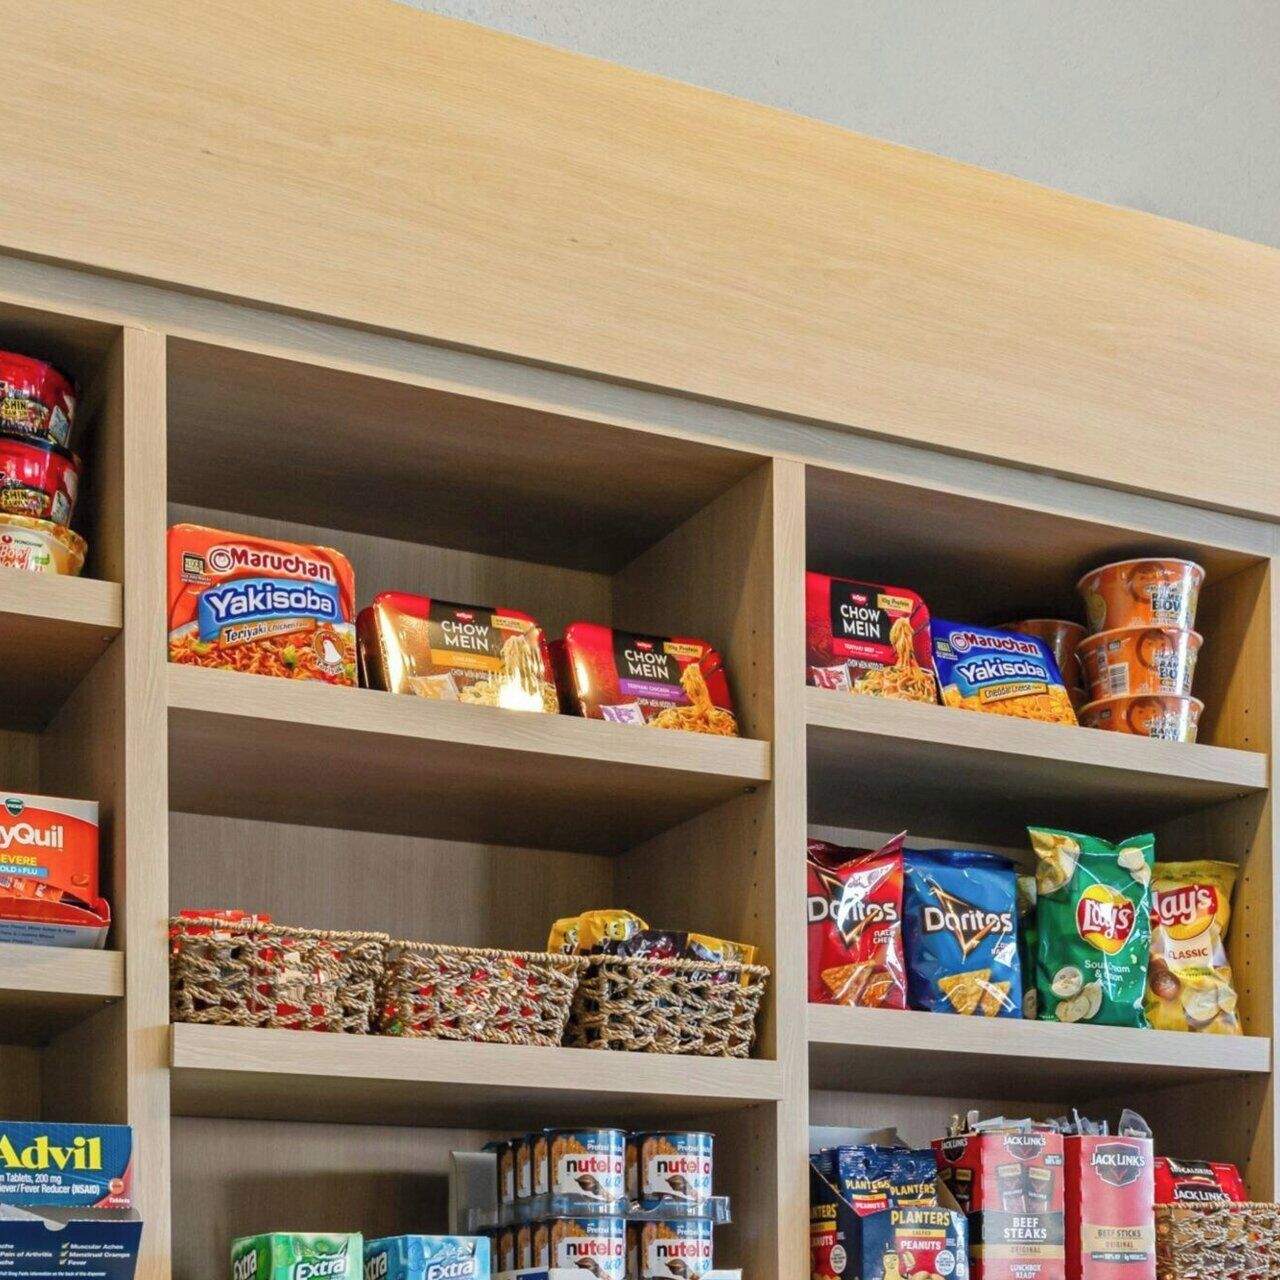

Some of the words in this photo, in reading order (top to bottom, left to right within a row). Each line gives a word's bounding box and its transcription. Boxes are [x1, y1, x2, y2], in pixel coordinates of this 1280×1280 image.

[4, 399, 27, 411] SHIN
[3, 489, 27, 501] SHIN
[230, 547, 331, 580] Maruchan
[210, 585, 333, 618] Yakisoba
[840, 604, 880, 622] CHOW
[440, 620, 489, 637] CHOW
[843, 618, 880, 638] MEIN
[444, 633, 489, 651] MEIN
[964, 632, 1039, 654] Maruchan
[624, 649, 668, 665] CHOW
[628, 661, 670, 679] MEIN
[961, 659, 1046, 682] Yakisoba
[22, 867, 38, 876] FLU
[924, 907, 1013, 932] Doritos
[1082, 900, 1132, 938] Lay's
[1168, 947, 1209, 961] CLASSIC
[1003, 1136, 1023, 1146] JACK
[1023, 1136, 1047, 1146] LINK'S
[1090, 1153, 1116, 1166] JACK
[1116, 1153, 1146, 1167] LINK'S
[6, 1172, 34, 1184] Tablets,
[35, 1174, 49, 1183] 200
[50, 1176, 62, 1185] mg
[889, 1183, 936, 1196] PLANTERS
[1173, 1188, 1199, 1200] JACK
[1199, 1191, 1231, 1202] LINK'S
[855, 1201, 886, 1210] PEANUTS
[890, 1210, 950, 1227] PLANTERS
[1012, 1217, 1039, 1229] BEEF
[1003, 1228, 1048, 1240] STEAKS
[1097, 1229, 1116, 1238] BEEF
[1116, 1229, 1142, 1238] STICKS
[900, 1240, 941, 1251] PEANUTS
[1010, 1263, 1042, 1272] LUNCHBOX
[1015, 1271, 1036, 1280] READY
